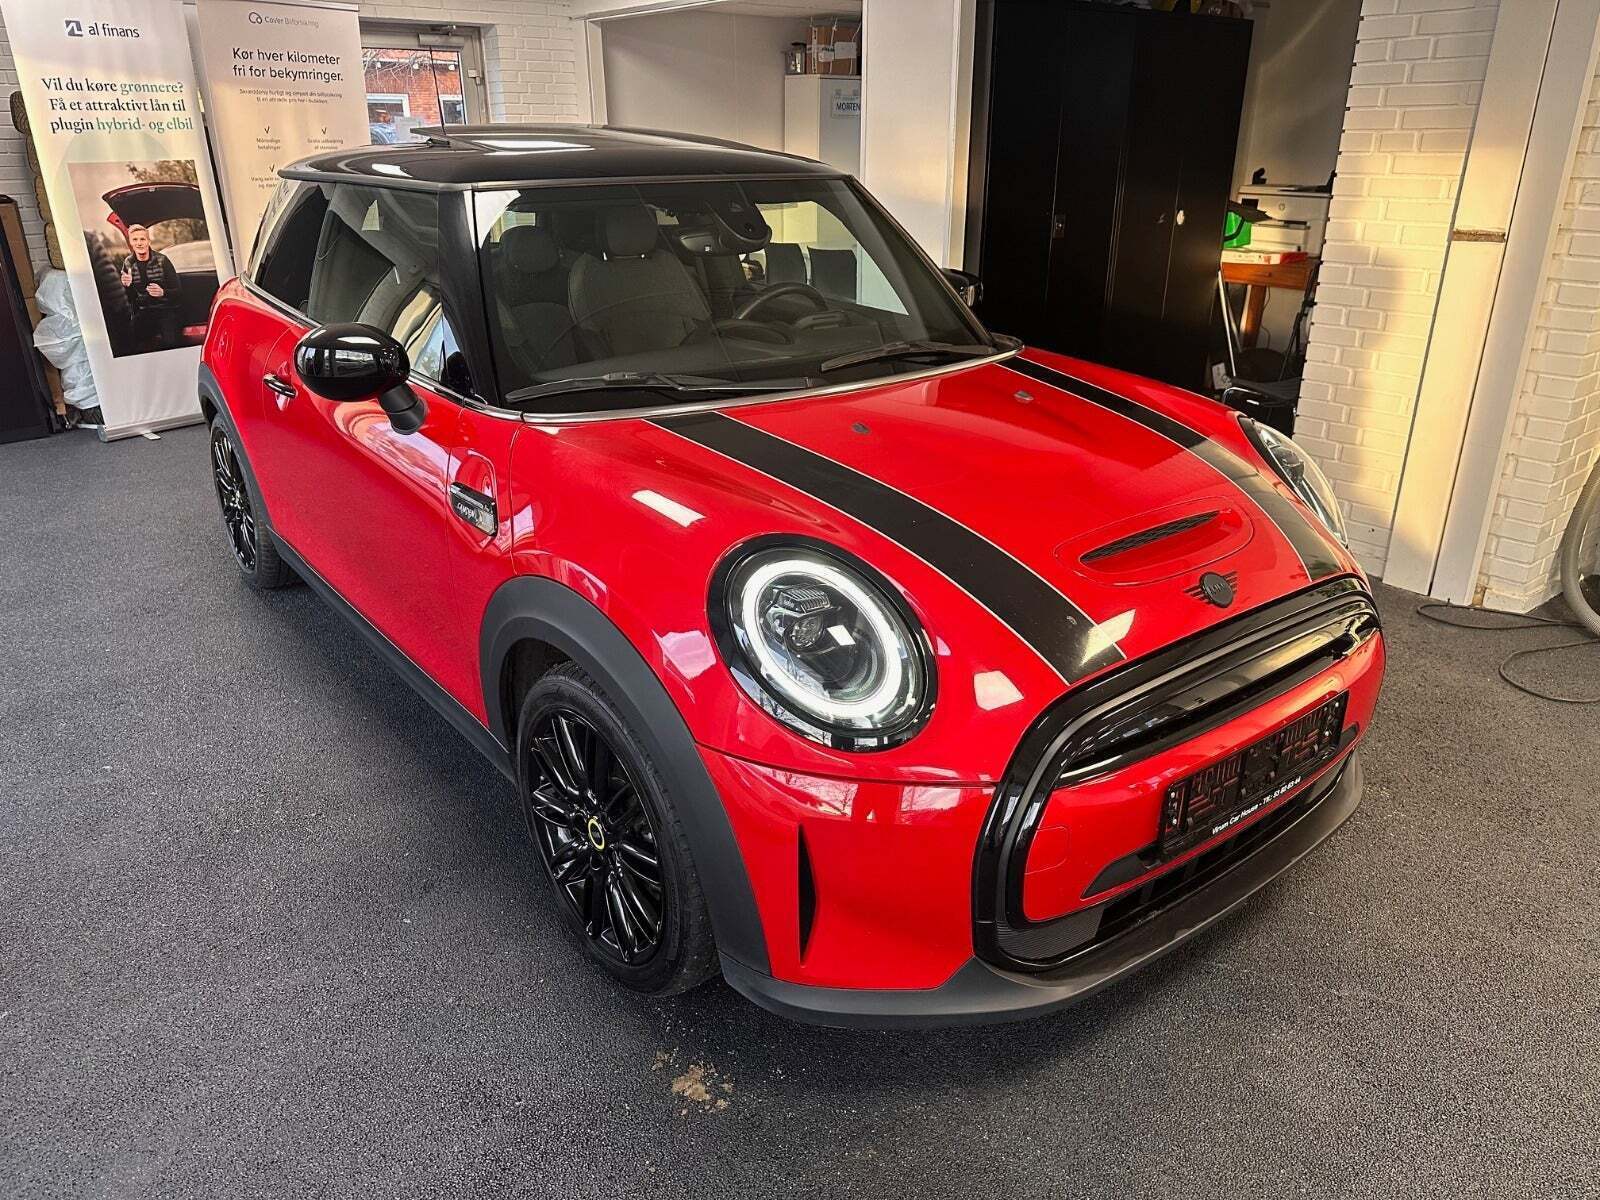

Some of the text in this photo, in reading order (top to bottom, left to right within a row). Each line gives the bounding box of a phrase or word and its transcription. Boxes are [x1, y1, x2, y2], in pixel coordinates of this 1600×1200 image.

[264, 16, 283, 25] Cover
[88, 23, 140, 38] al finans
[232, 47, 340, 65] Kør hver kilometer
[232, 65, 344, 83] fri for bekymringer.
[41, 77, 184, 96] Vil du køre grønnere?
[49, 97, 186, 112] Få et attraktivt lån til
[50, 117, 193, 135] plugin hybrid- og elbil
[1229, 814, 1240, 825] Car
[1240, 804, 1259, 818] House
